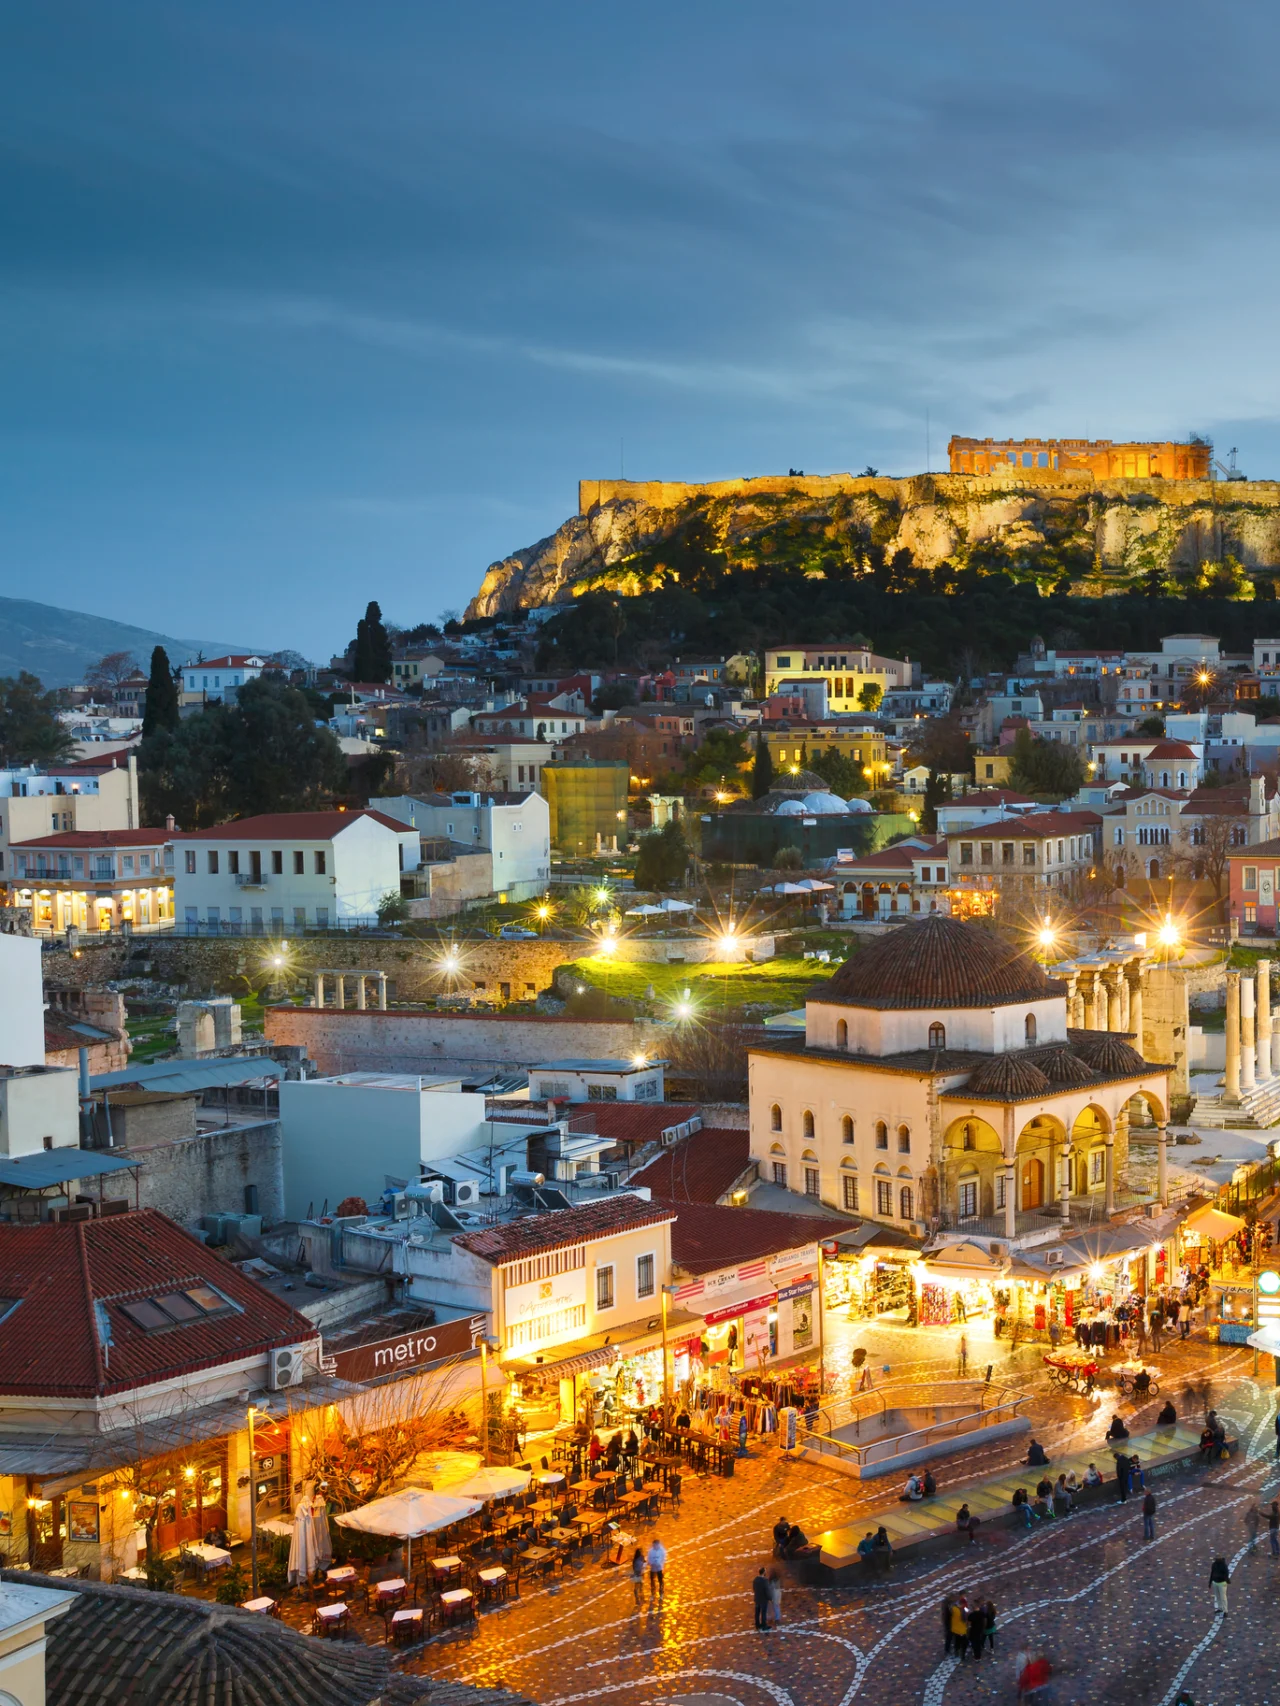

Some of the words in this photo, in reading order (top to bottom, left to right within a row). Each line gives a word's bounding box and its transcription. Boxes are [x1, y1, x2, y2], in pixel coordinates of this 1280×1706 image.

[800, 1248, 816, 1257] TRAVEL
[717, 1273, 736, 1284] CREAM
[788, 1288, 797, 1297] Star
[797, 1283, 813, 1293] Ferries
[375, 1335, 437, 1367] metro
[635, 1345, 657, 1356] GREEK
